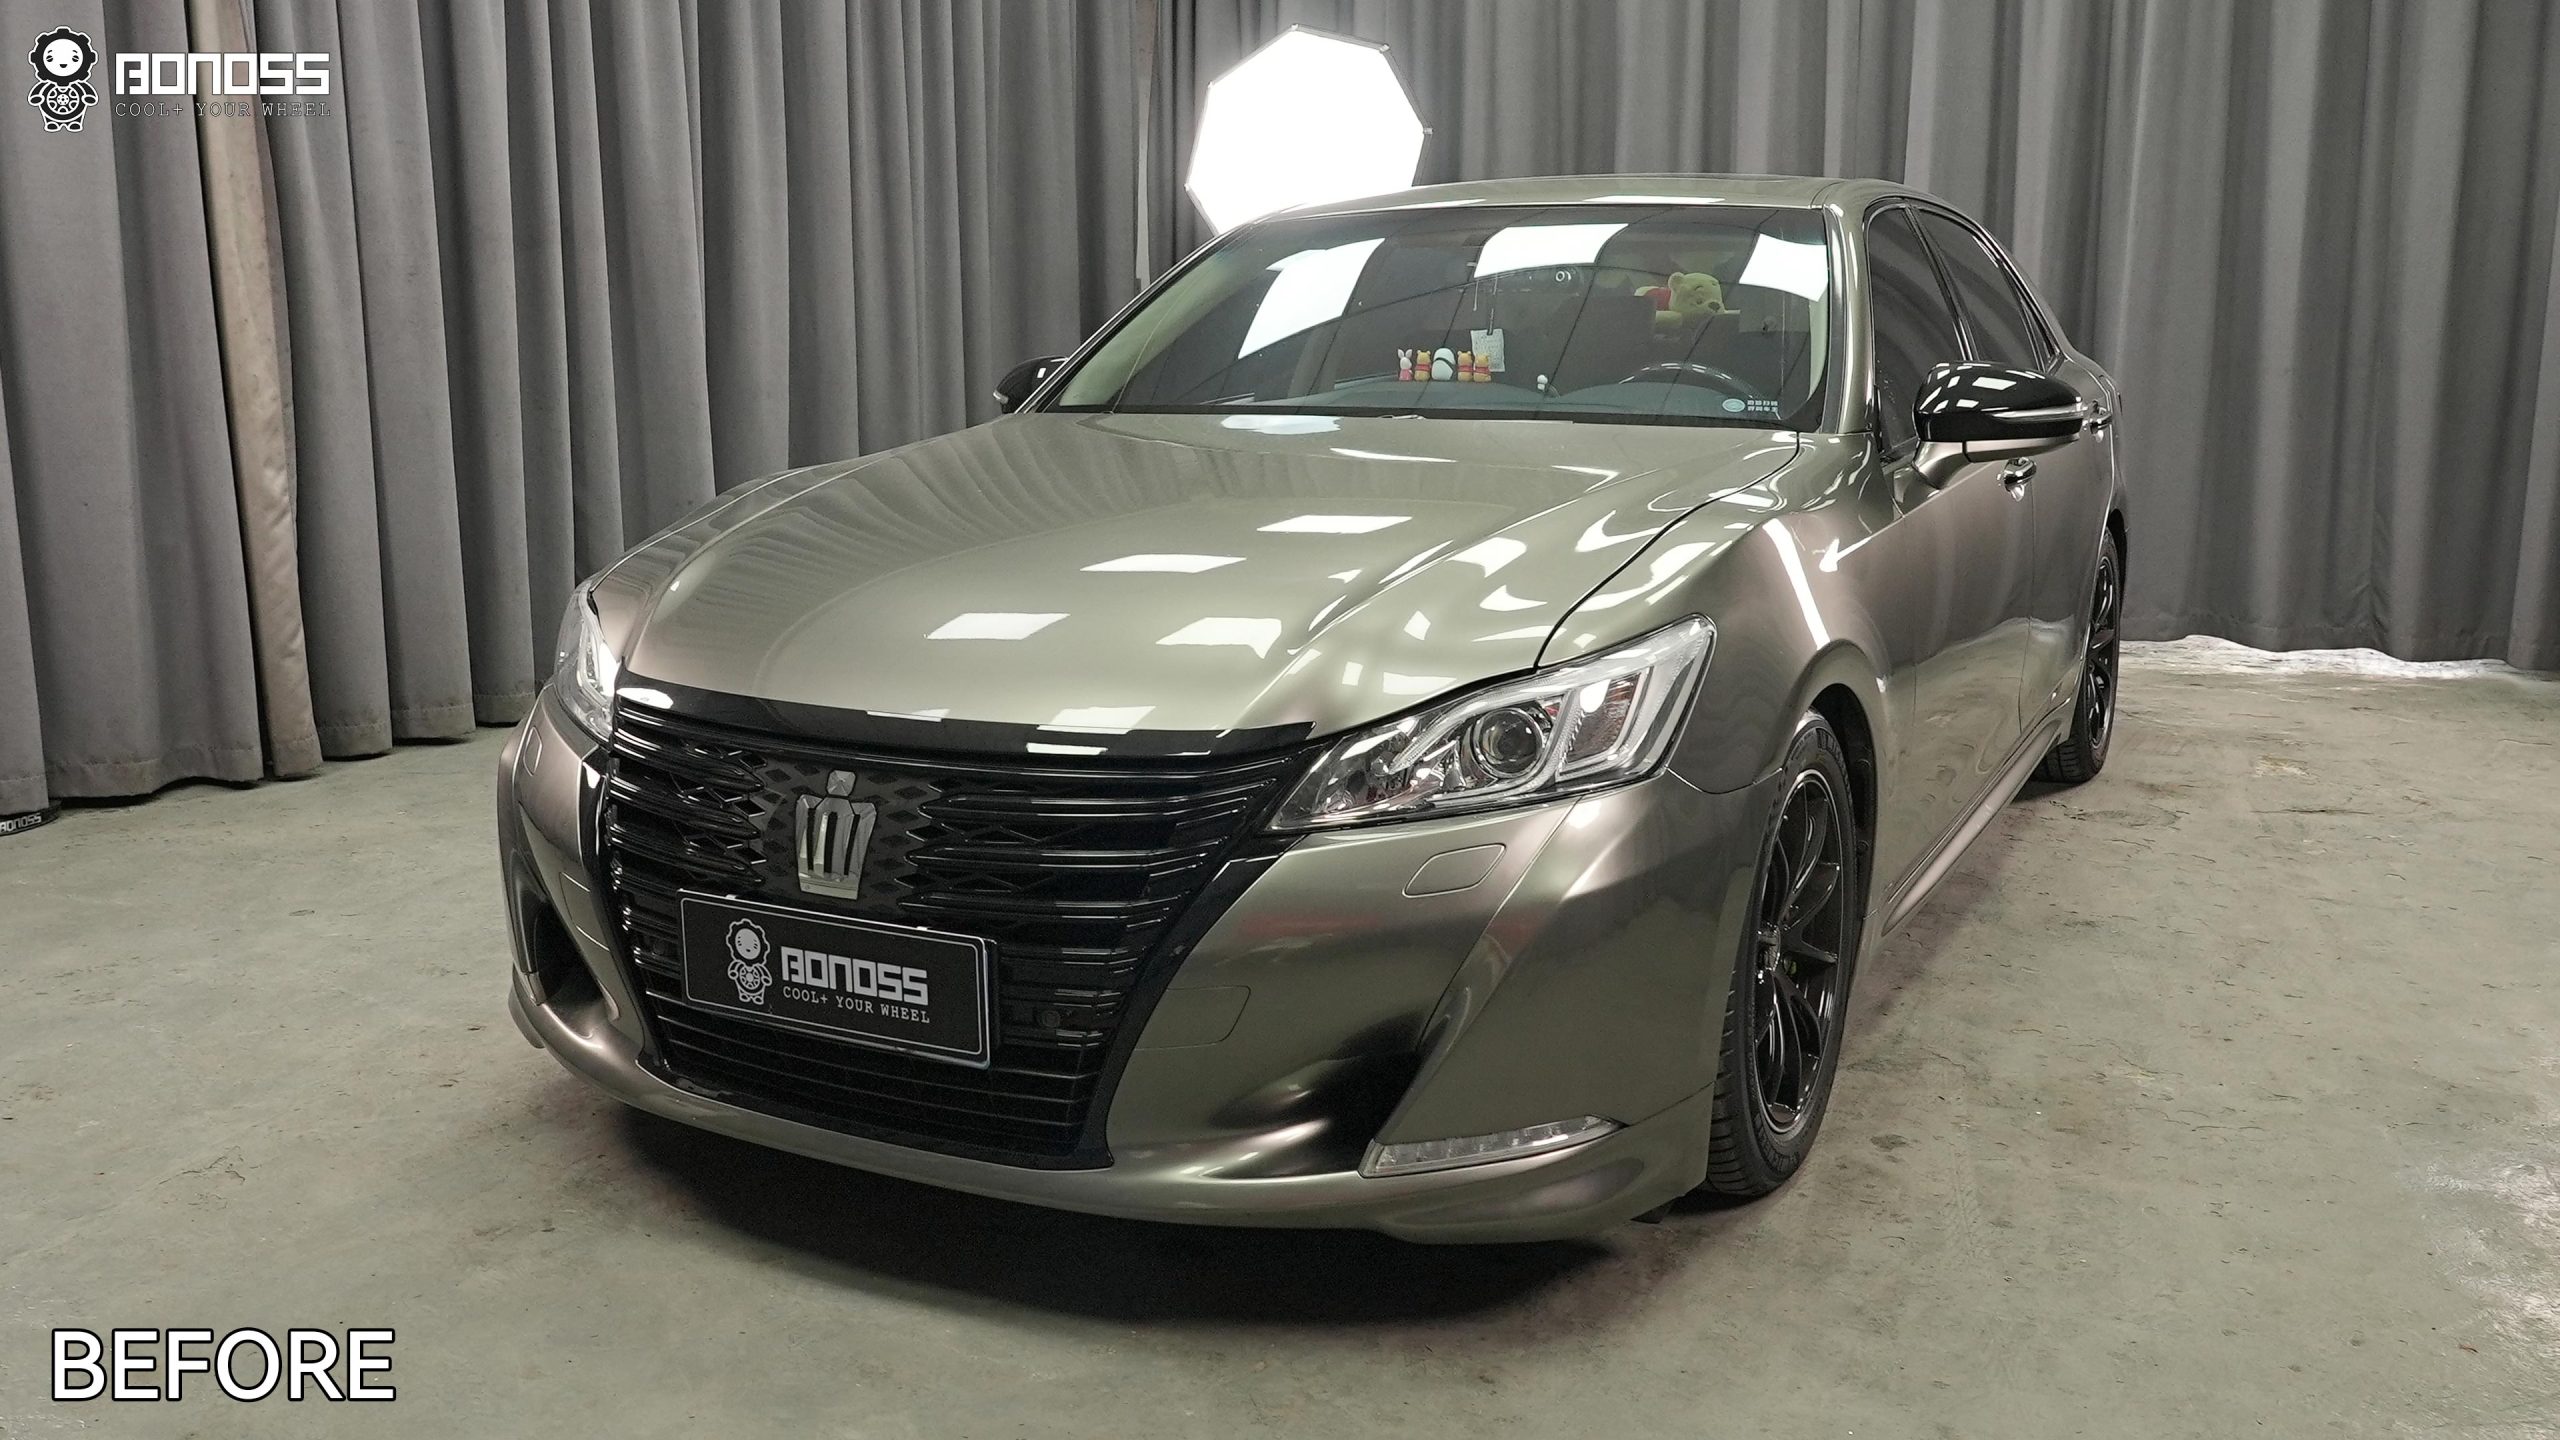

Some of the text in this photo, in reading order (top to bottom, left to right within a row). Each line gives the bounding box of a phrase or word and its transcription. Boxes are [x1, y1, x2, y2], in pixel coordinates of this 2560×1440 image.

[780, 946, 929, 1006] BONOSS
[782, 985, 930, 1024] COOL+ YOUR WHEEL
